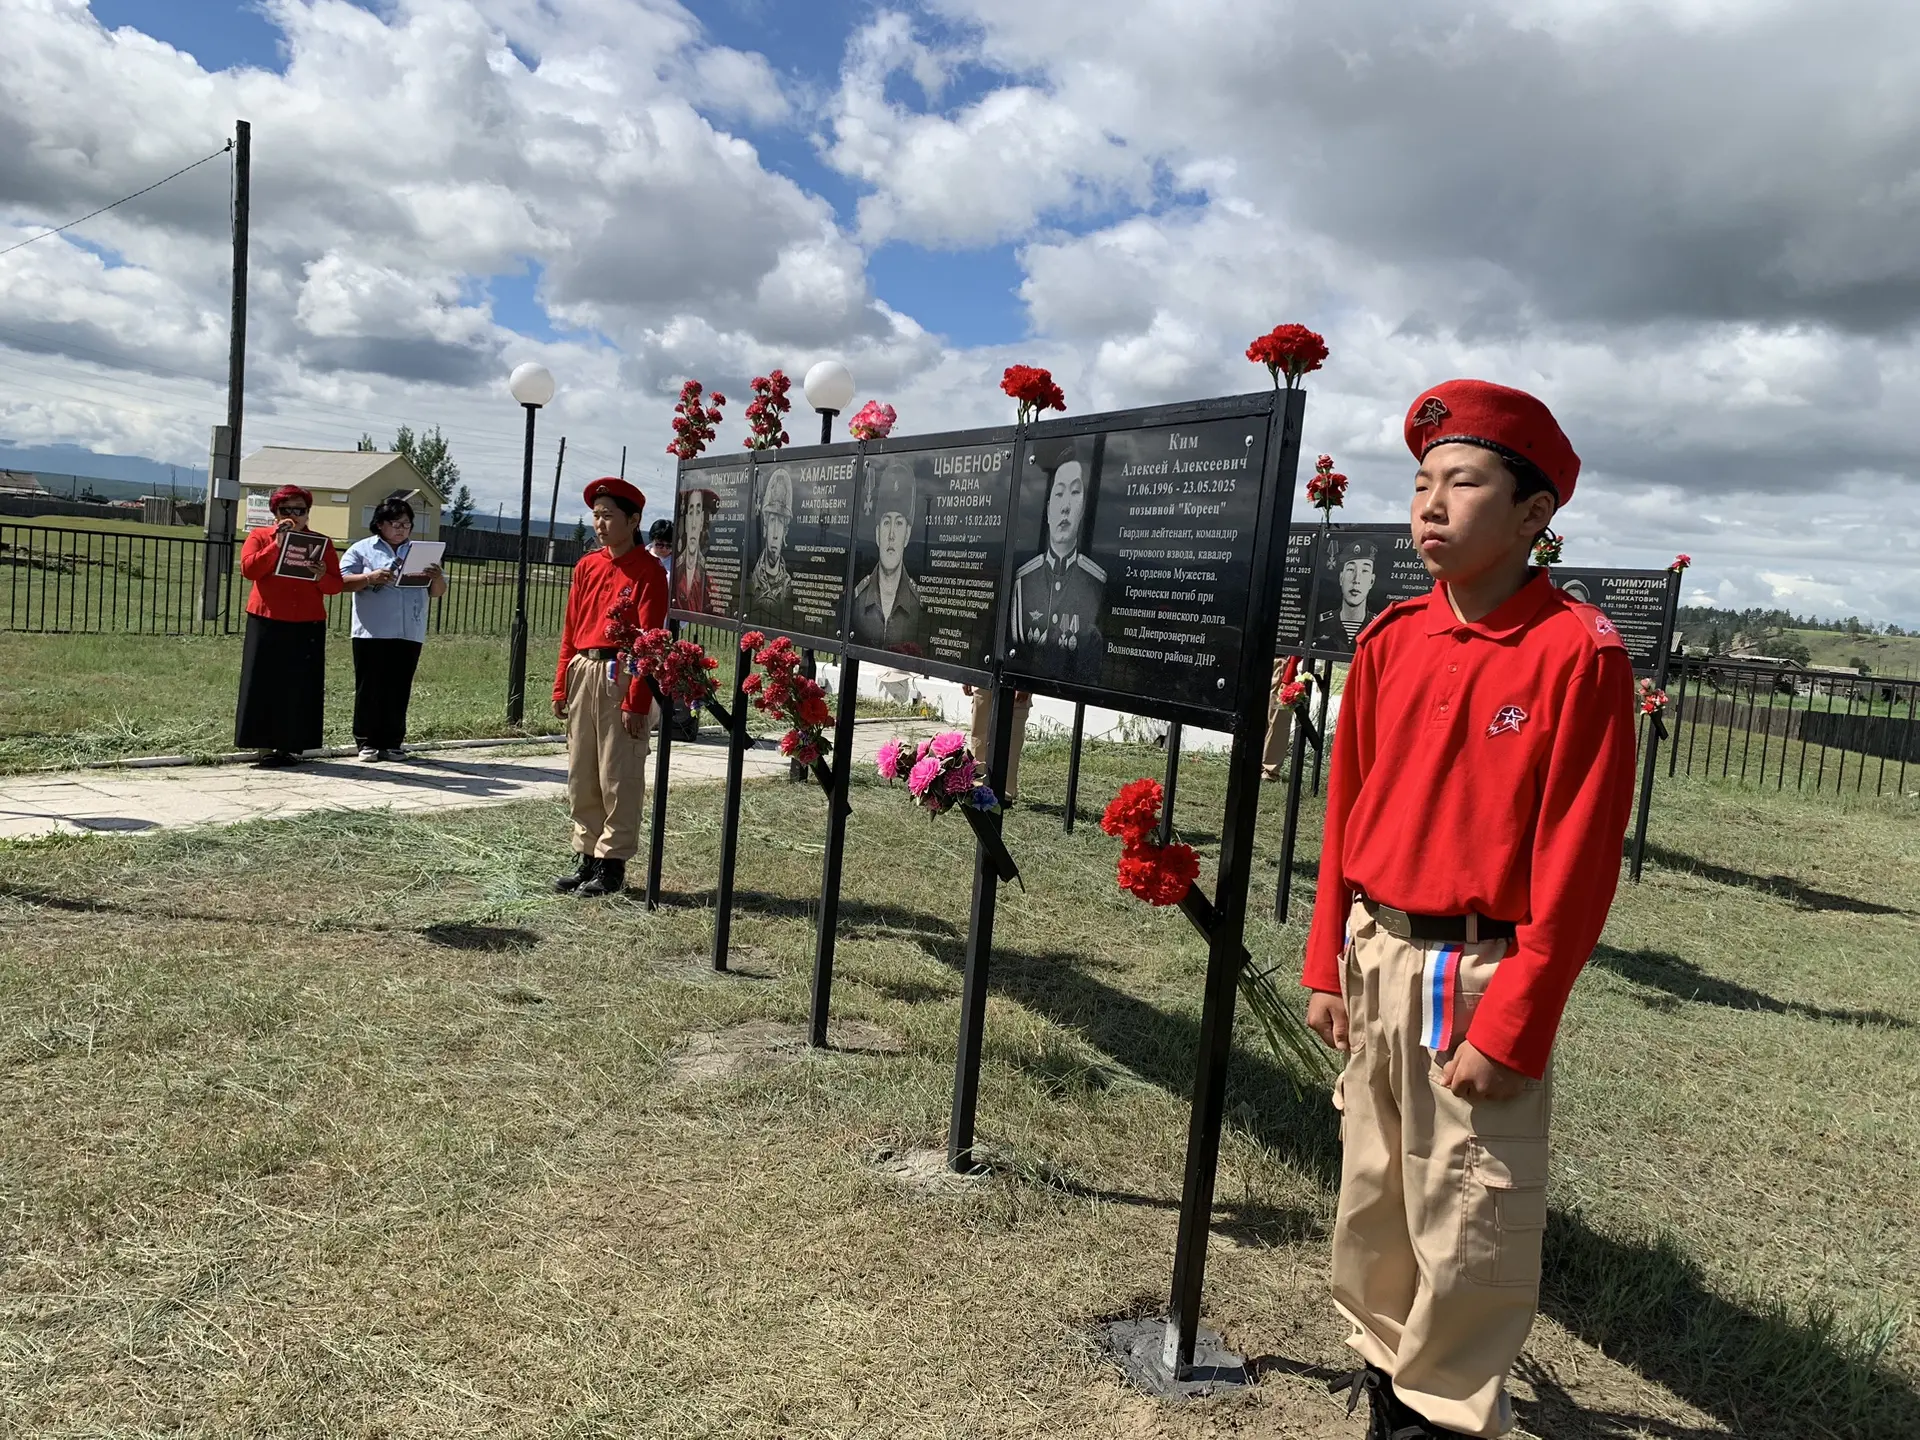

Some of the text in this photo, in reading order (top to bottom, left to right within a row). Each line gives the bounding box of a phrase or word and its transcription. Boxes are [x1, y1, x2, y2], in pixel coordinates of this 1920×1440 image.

[1168, 433, 1199, 450] Ким
[800, 464, 853, 482] ХАМАЛЕЕВ
[934, 453, 1001, 478] ЦЫБЕНОВ
[1120, 457, 1247, 476] Алексей Алексеевич
[812, 485, 836, 495] САНГАТ
[950, 478, 980, 492] РАДНА
[1126, 482, 1173, 496] 17.06.1996
[1182, 479, 1236, 494] 23.05.2025
[801, 499, 846, 509] АНАТОЛЬЕВИЧ
[936, 495, 992, 508] ТУМЭНОВИЧ
[1129, 501, 1226, 517] позывной "Кореец"
[925, 515, 958, 526] 13.11.1997
[965, 515, 1002, 526] 15.02.2023
[1119, 526, 1238, 542] Гвардии лейтенант, командир
[1119, 548, 1232, 563] штурмового взвода, кавалер
[1126, 566, 1218, 582] 2-х орденов Мужества.
[1602, 578, 1666, 589] ГАЛИМУЛИН
[1125, 586, 1214, 604] Героически погиб при
[1112, 606, 1226, 625] исполнении воинского долга
[1124, 626, 1206, 644] под Днепроэнергией
[1107, 642, 1163, 660] Волновахского
[1164, 652, 1194, 664] района
[1194, 653, 1216, 667] ДНР
